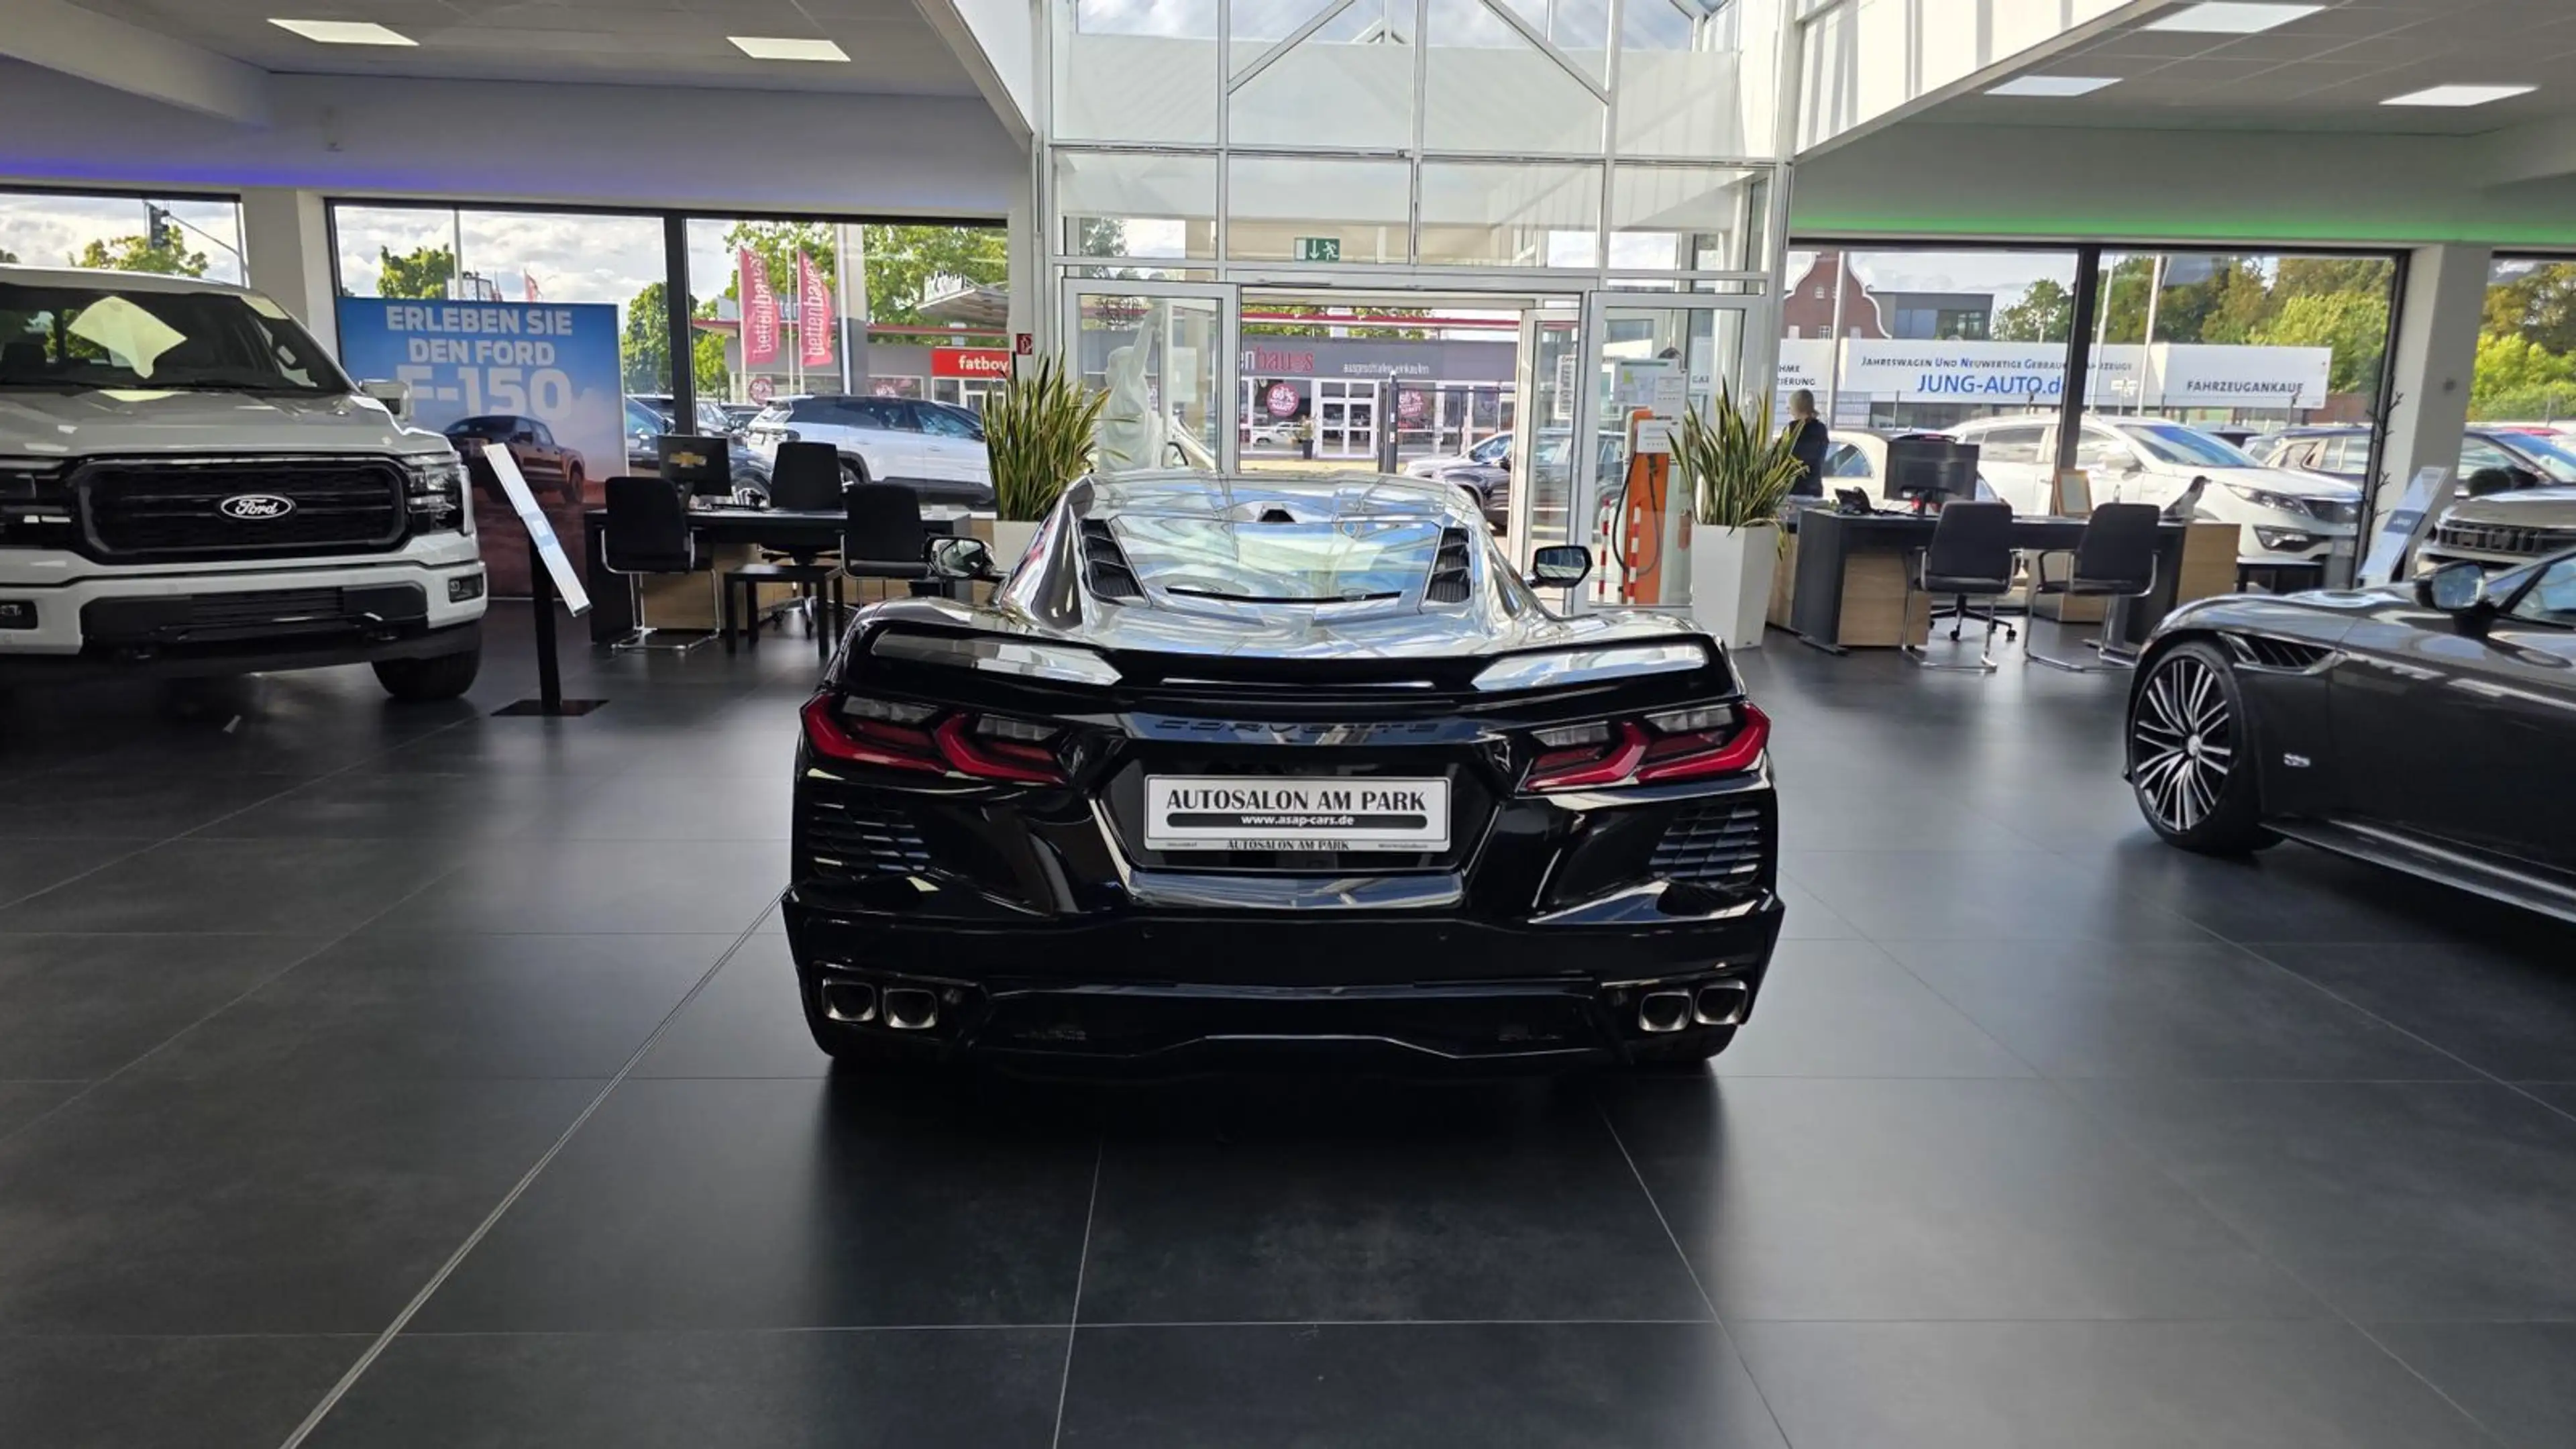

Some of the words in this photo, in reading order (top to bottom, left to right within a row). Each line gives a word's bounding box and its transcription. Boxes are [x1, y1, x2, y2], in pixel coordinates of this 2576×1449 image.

[386, 306, 520, 334] ERLEBEN
[526, 309, 572, 335] SIE
[409, 337, 468, 363] DEN
[474, 340, 555, 366] FORD
[959, 355, 1008, 372] fatboy
[1917, 374, 2064, 394] JUNG-AUTO.d
[2187, 380, 2304, 393] FAHRZEUGANKAUF
[397, 365, 572, 422] F-150
[235, 498, 278, 515] Ford
[1167, 789, 1308, 810] AUTOSALON
[1317, 790, 1352, 810] AM
[1361, 791, 1426, 811] PARK
[1240, 814, 1354, 827] www.asap-cars.de
[1226, 839, 1293, 850] AUTOSALON
[1297, 840, 1314, 851] AM
[1318, 840, 1350, 851] PARK
